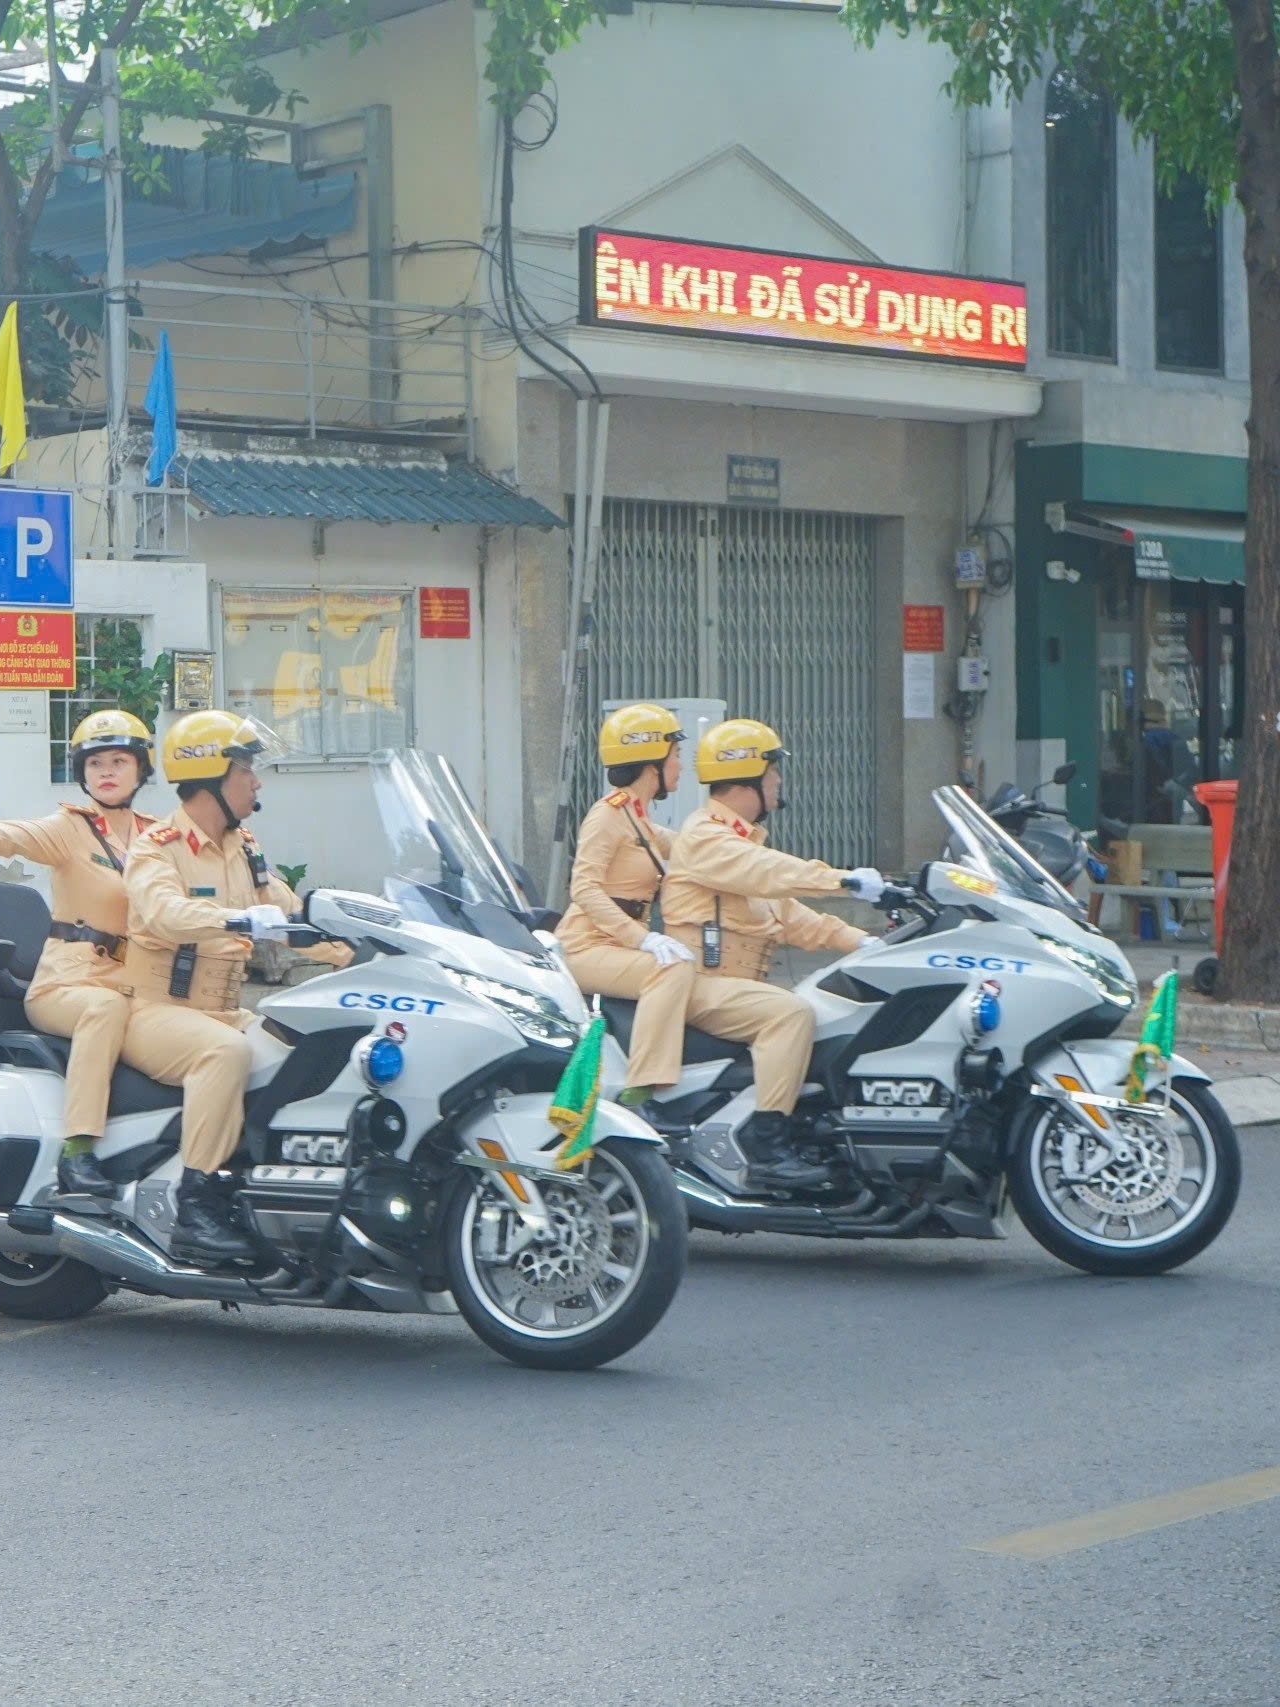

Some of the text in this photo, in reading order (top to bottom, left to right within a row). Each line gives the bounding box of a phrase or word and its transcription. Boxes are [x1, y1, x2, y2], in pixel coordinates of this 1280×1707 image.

[661, 262, 736, 315] KHI
[747, 265, 806, 323] ĐÃ
[814, 272, 871, 328] SỬ
[877, 289, 982, 347] DỤNG
[16, 516, 54, 578] P
[19, 643, 27, 654] XE
[620, 731, 661, 744] CSGT
[174, 745, 218, 761] CSGT
[716, 747, 757, 761] CSGT
